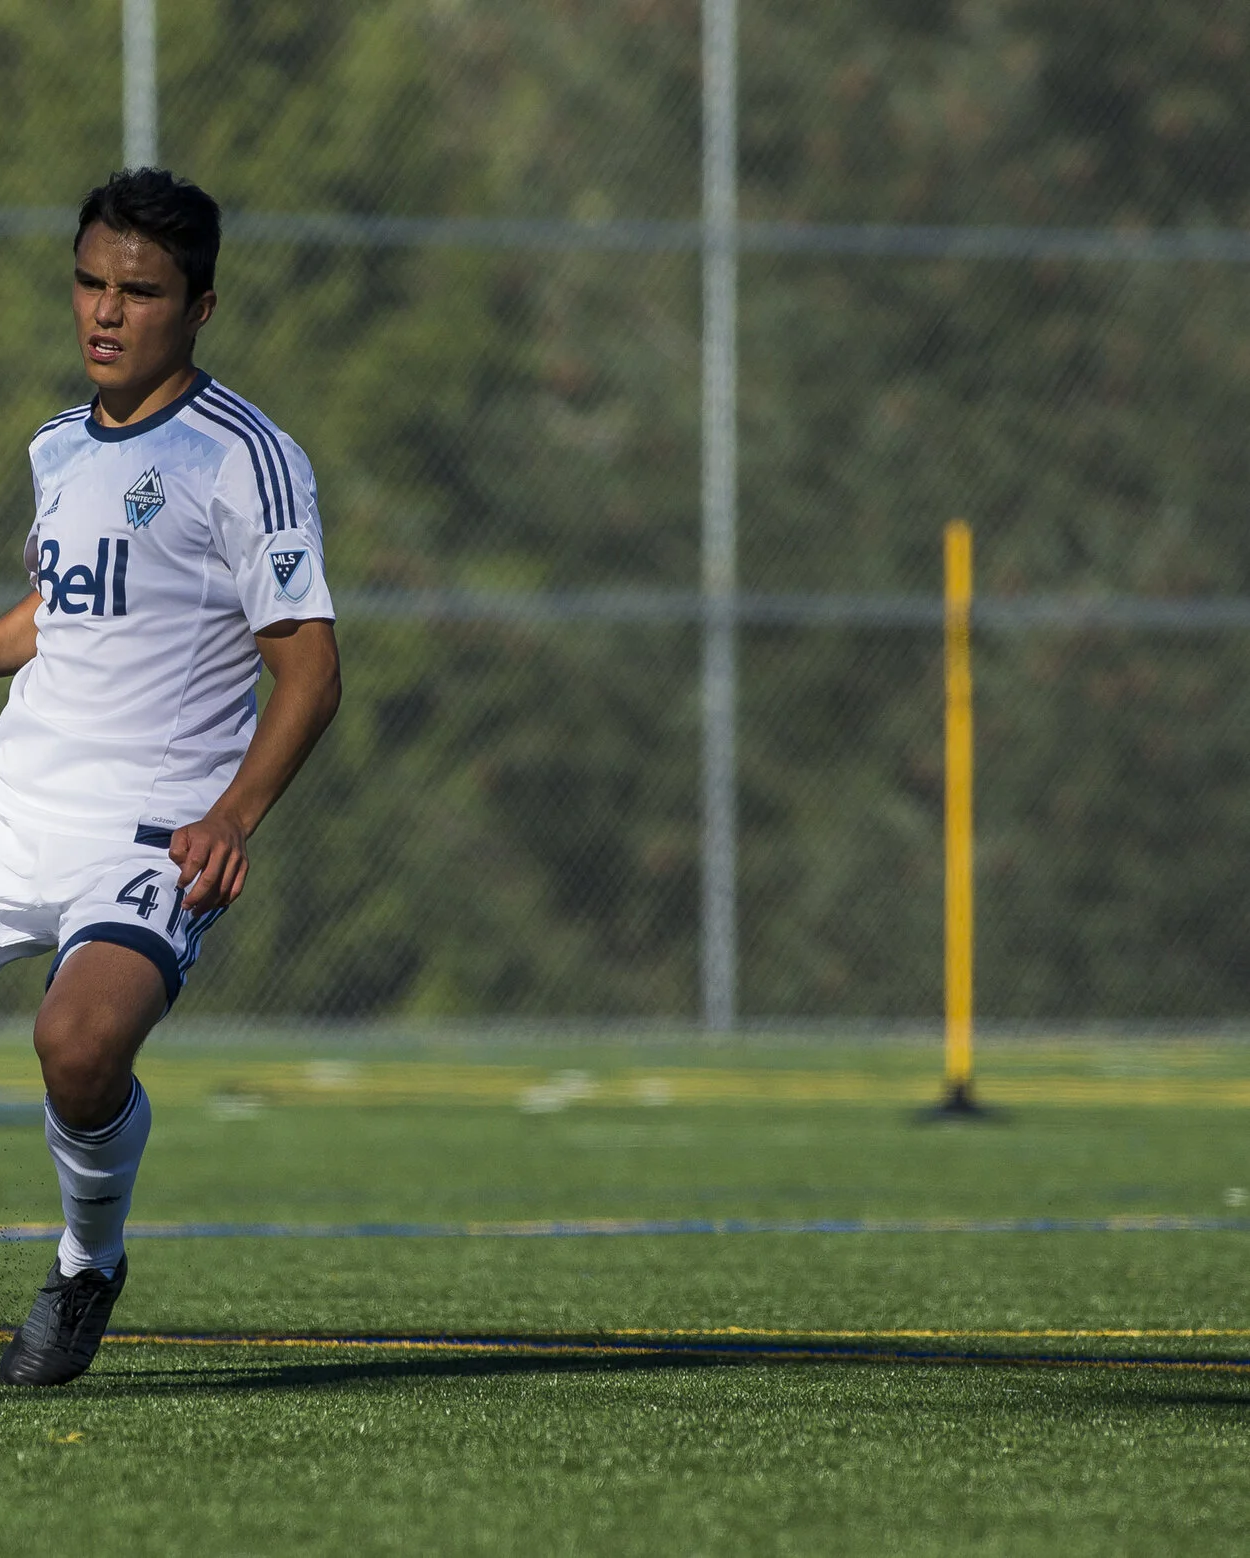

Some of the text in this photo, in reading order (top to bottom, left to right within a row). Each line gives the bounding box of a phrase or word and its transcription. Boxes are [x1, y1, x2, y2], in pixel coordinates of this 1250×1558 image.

[125, 494, 164, 505] WHITECAPS
[38, 537, 129, 616] Bell
[272, 553, 296, 566] MLS
[116, 868, 187, 939] 41
